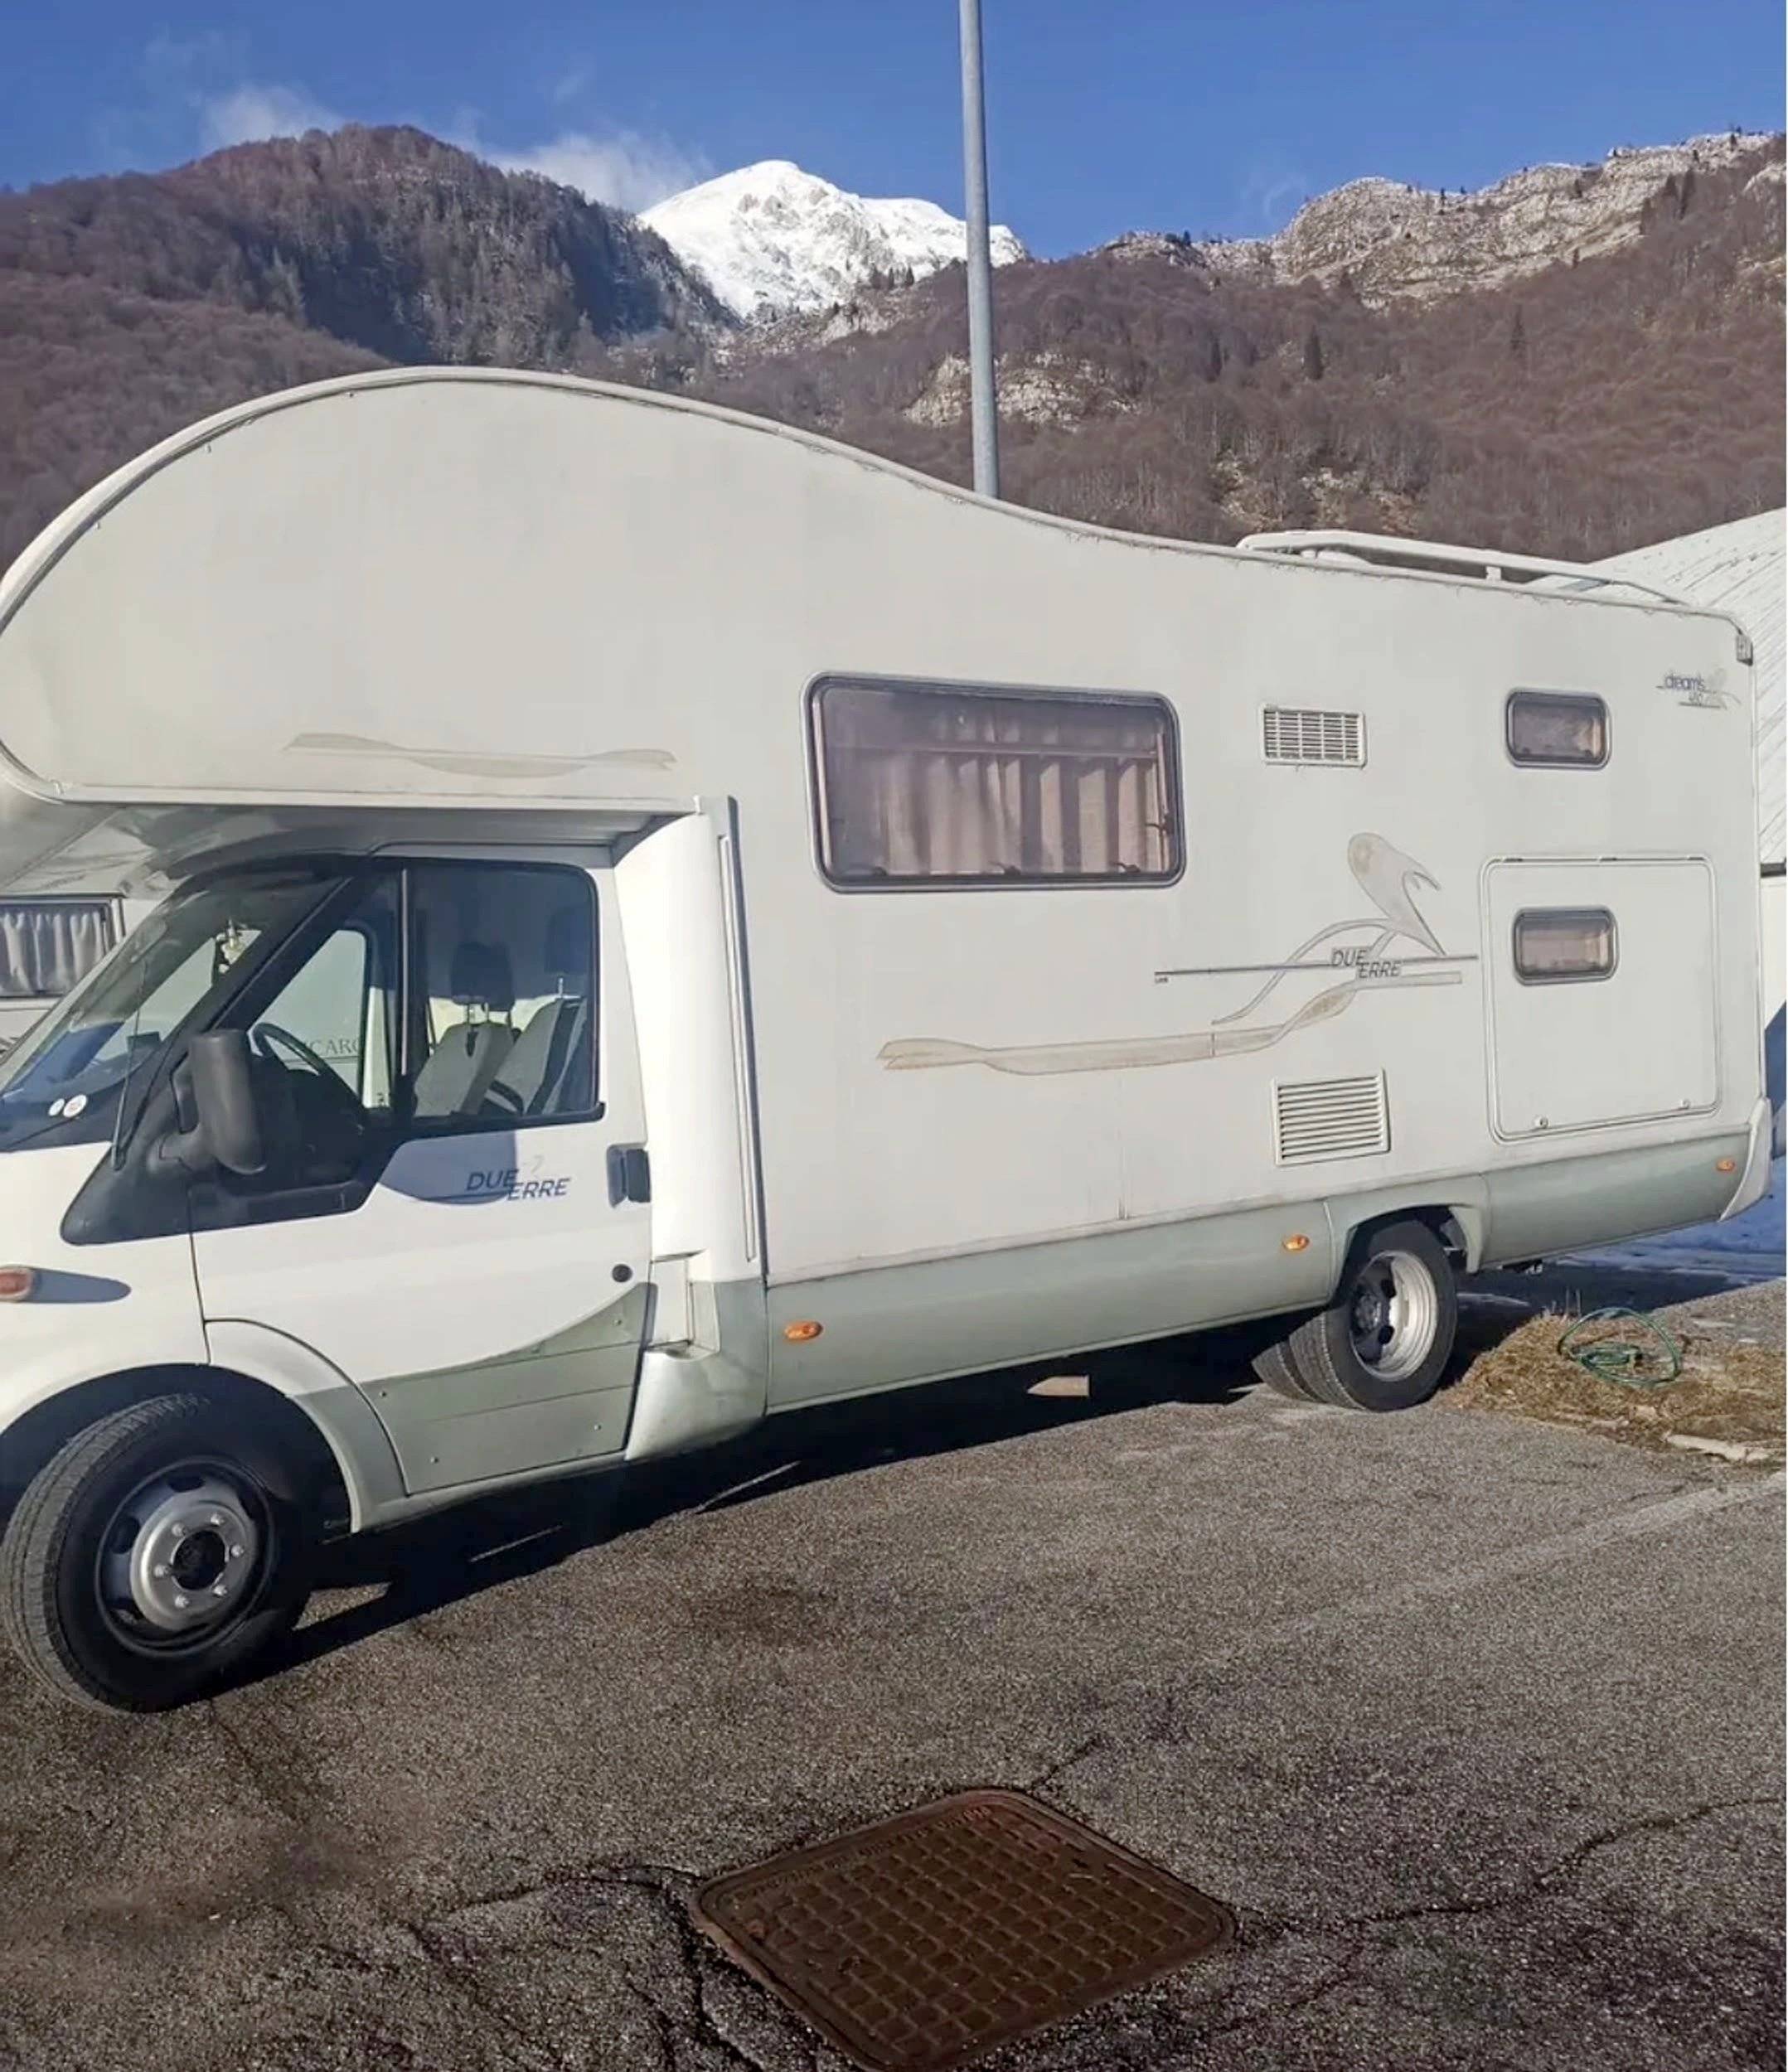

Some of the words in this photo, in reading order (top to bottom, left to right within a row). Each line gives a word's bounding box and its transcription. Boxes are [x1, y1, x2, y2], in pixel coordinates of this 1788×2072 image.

[1331, 948, 1368, 966] DUE
[1357, 961, 1402, 978] ERRE
[467, 1169, 519, 1191] DUE
[507, 1178, 570, 1201] ERRE
